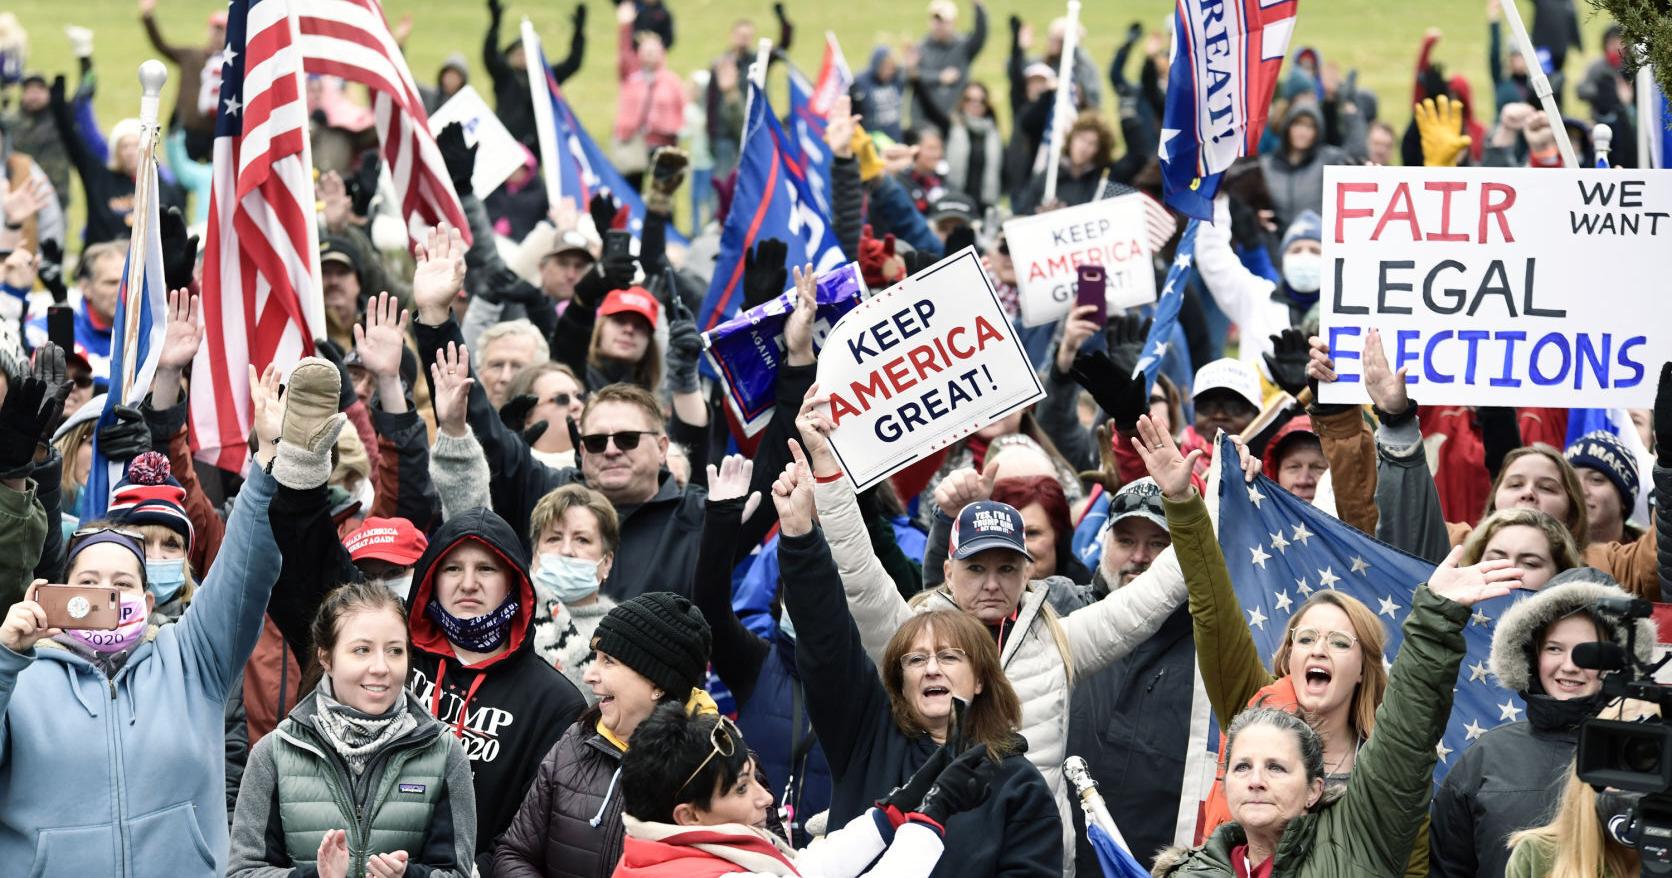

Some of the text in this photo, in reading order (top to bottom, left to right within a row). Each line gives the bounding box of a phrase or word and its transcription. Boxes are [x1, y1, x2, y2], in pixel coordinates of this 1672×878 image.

[1201, 0, 1236, 144] REAT!
[1334, 181, 1517, 244] FAIR
[1577, 180, 1646, 207] WE
[1051, 218, 1111, 247] KEEP
[1569, 210, 1671, 236] WANT
[1027, 239, 1143, 283] AMERICA
[1332, 257, 1567, 318] LEGAL
[751, 330, 777, 370] AGAIN!
[847, 298, 936, 365] KEEP
[829, 315, 1005, 427] AMERICA
[1328, 326, 1647, 390] EECTIONS
[874, 363, 998, 443] GREAT!
[1588, 443, 1633, 486] MAKE
[362, 527, 398, 538] AMERICA
[973, 518, 999, 529] TRUMP
[85, 631, 124, 646] 2020
